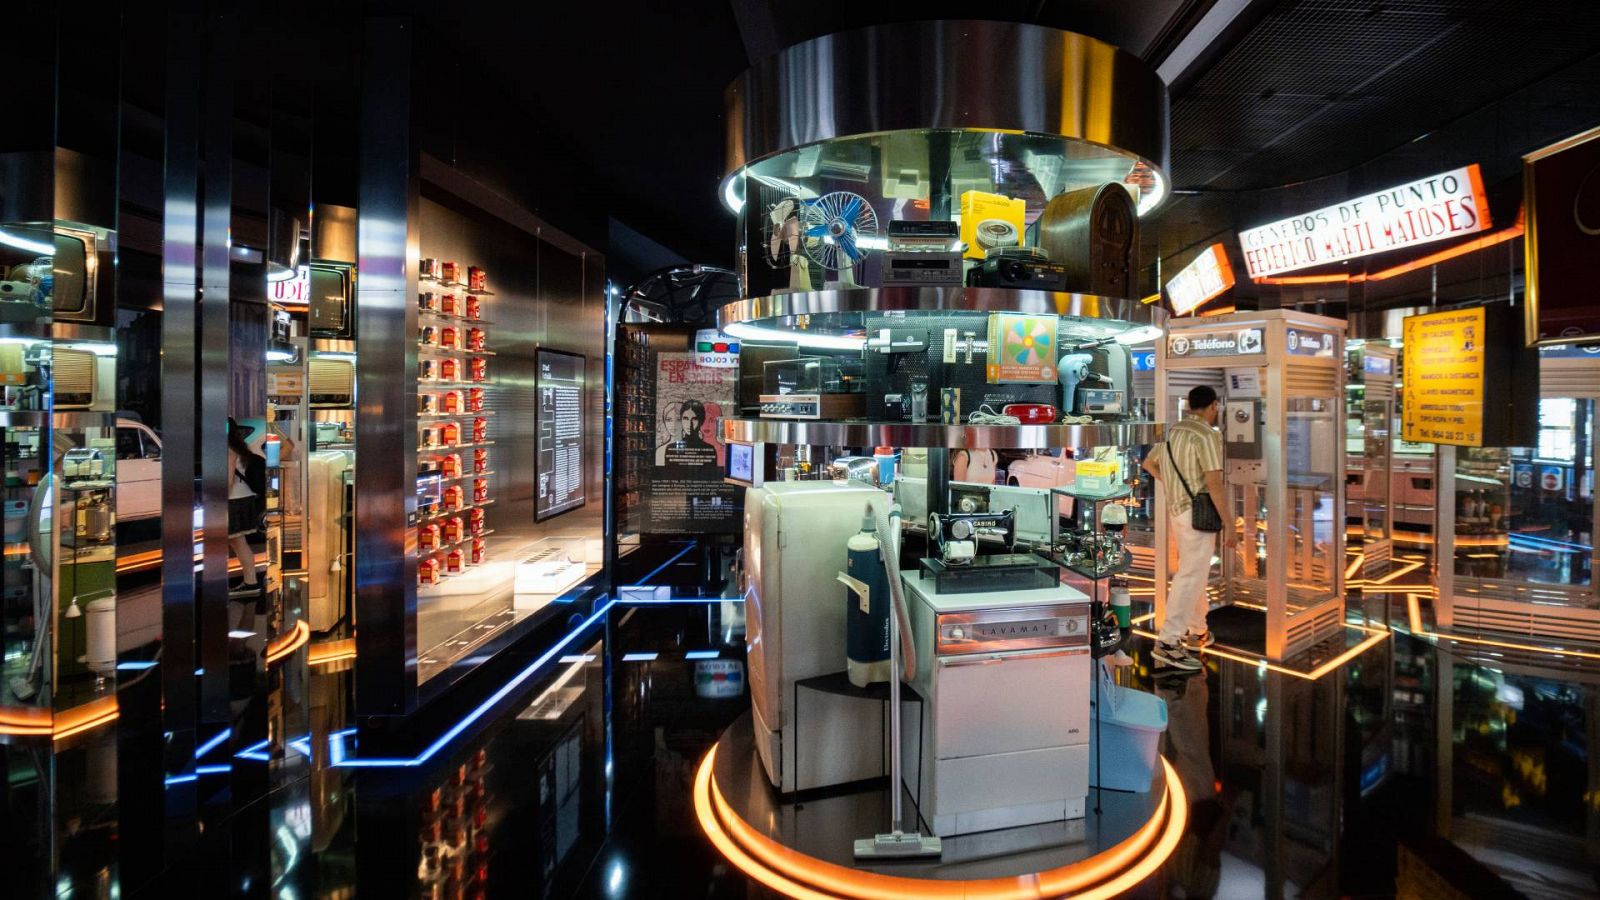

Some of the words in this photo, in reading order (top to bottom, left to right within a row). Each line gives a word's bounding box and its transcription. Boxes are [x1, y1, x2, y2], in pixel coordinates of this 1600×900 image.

[1338, 201, 1363, 224] DE
[1376, 174, 1460, 214] PUNTO
[1382, 194, 1478, 247] MATOSES
[1191, 338, 1236, 350] Teléfono
[669, 372, 684, 384] EN
[981, 624, 1048, 636] LAVAMAT
